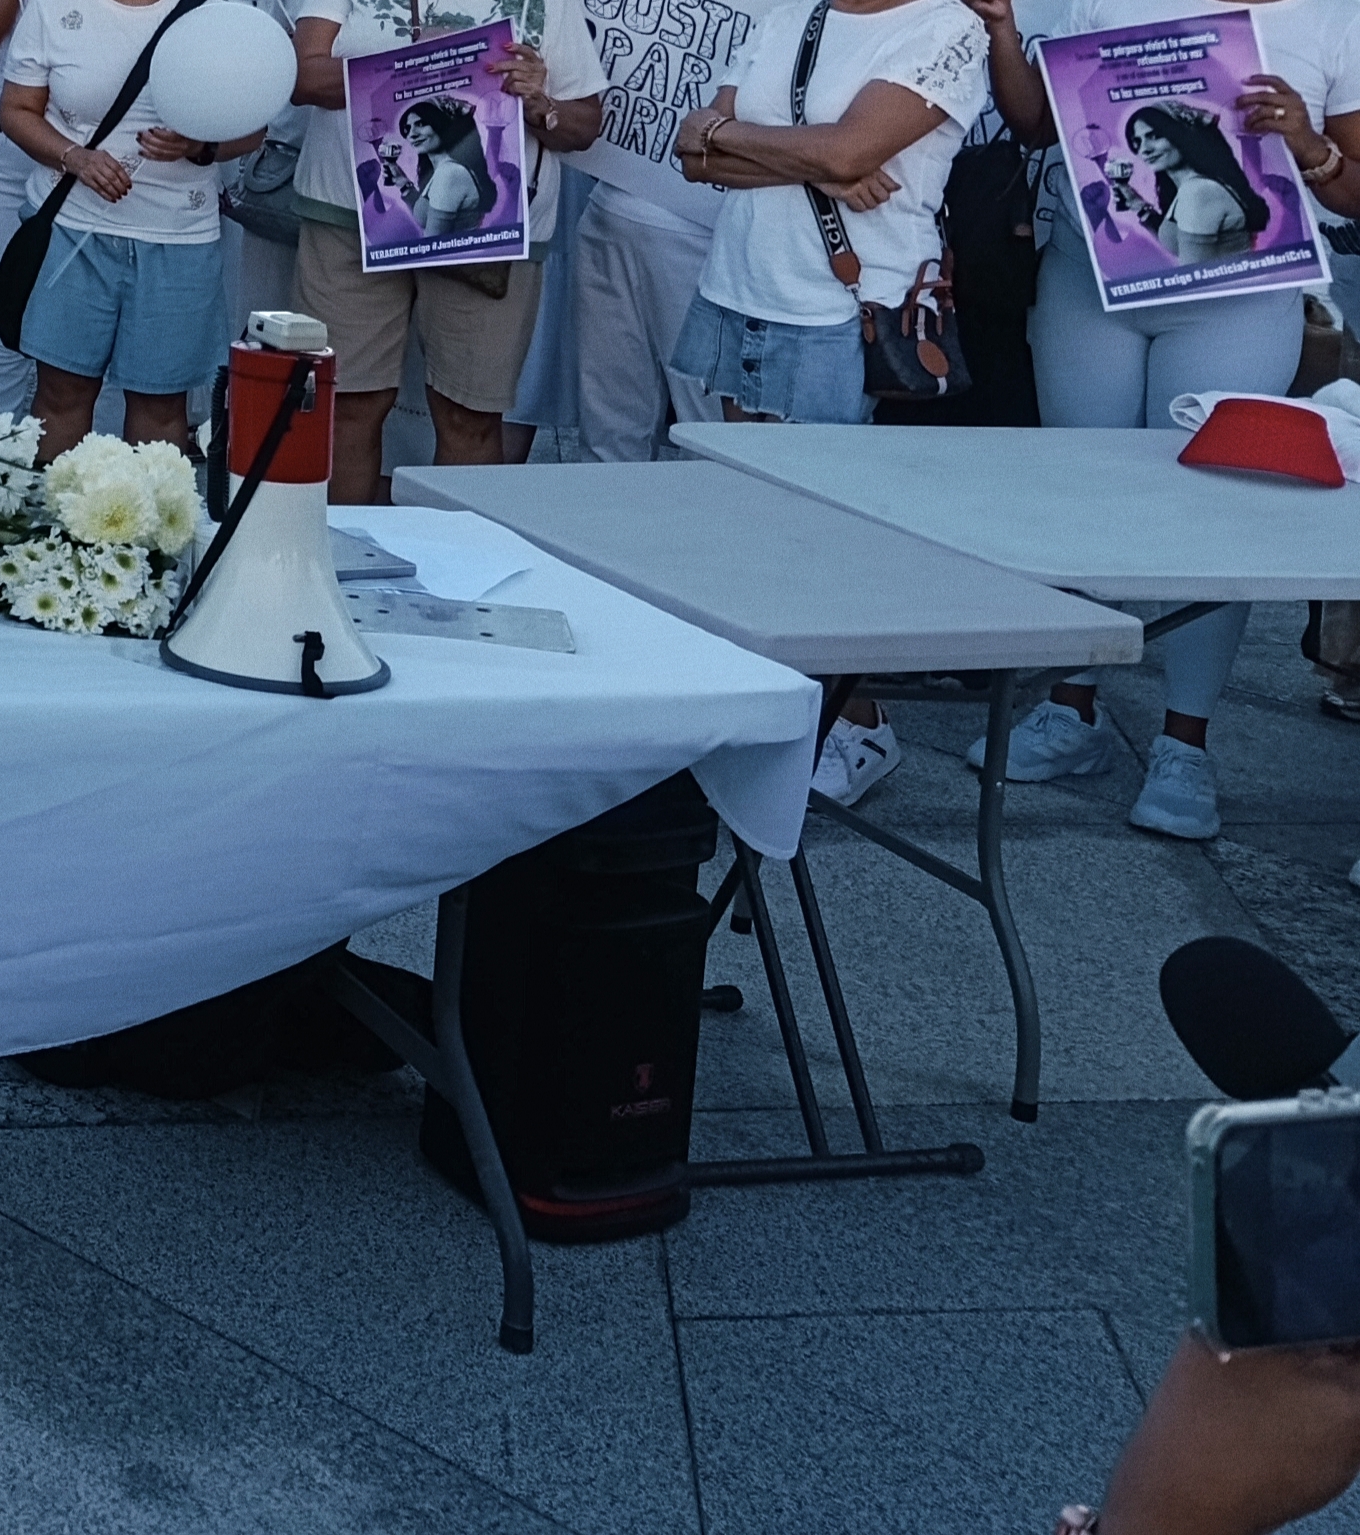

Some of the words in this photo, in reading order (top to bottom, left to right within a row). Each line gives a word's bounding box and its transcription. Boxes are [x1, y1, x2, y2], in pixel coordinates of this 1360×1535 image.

[599, 27, 712, 110] PAR
[1109, 277, 1163, 298] VERACRUZ
[1163, 272, 1193, 288] exige
